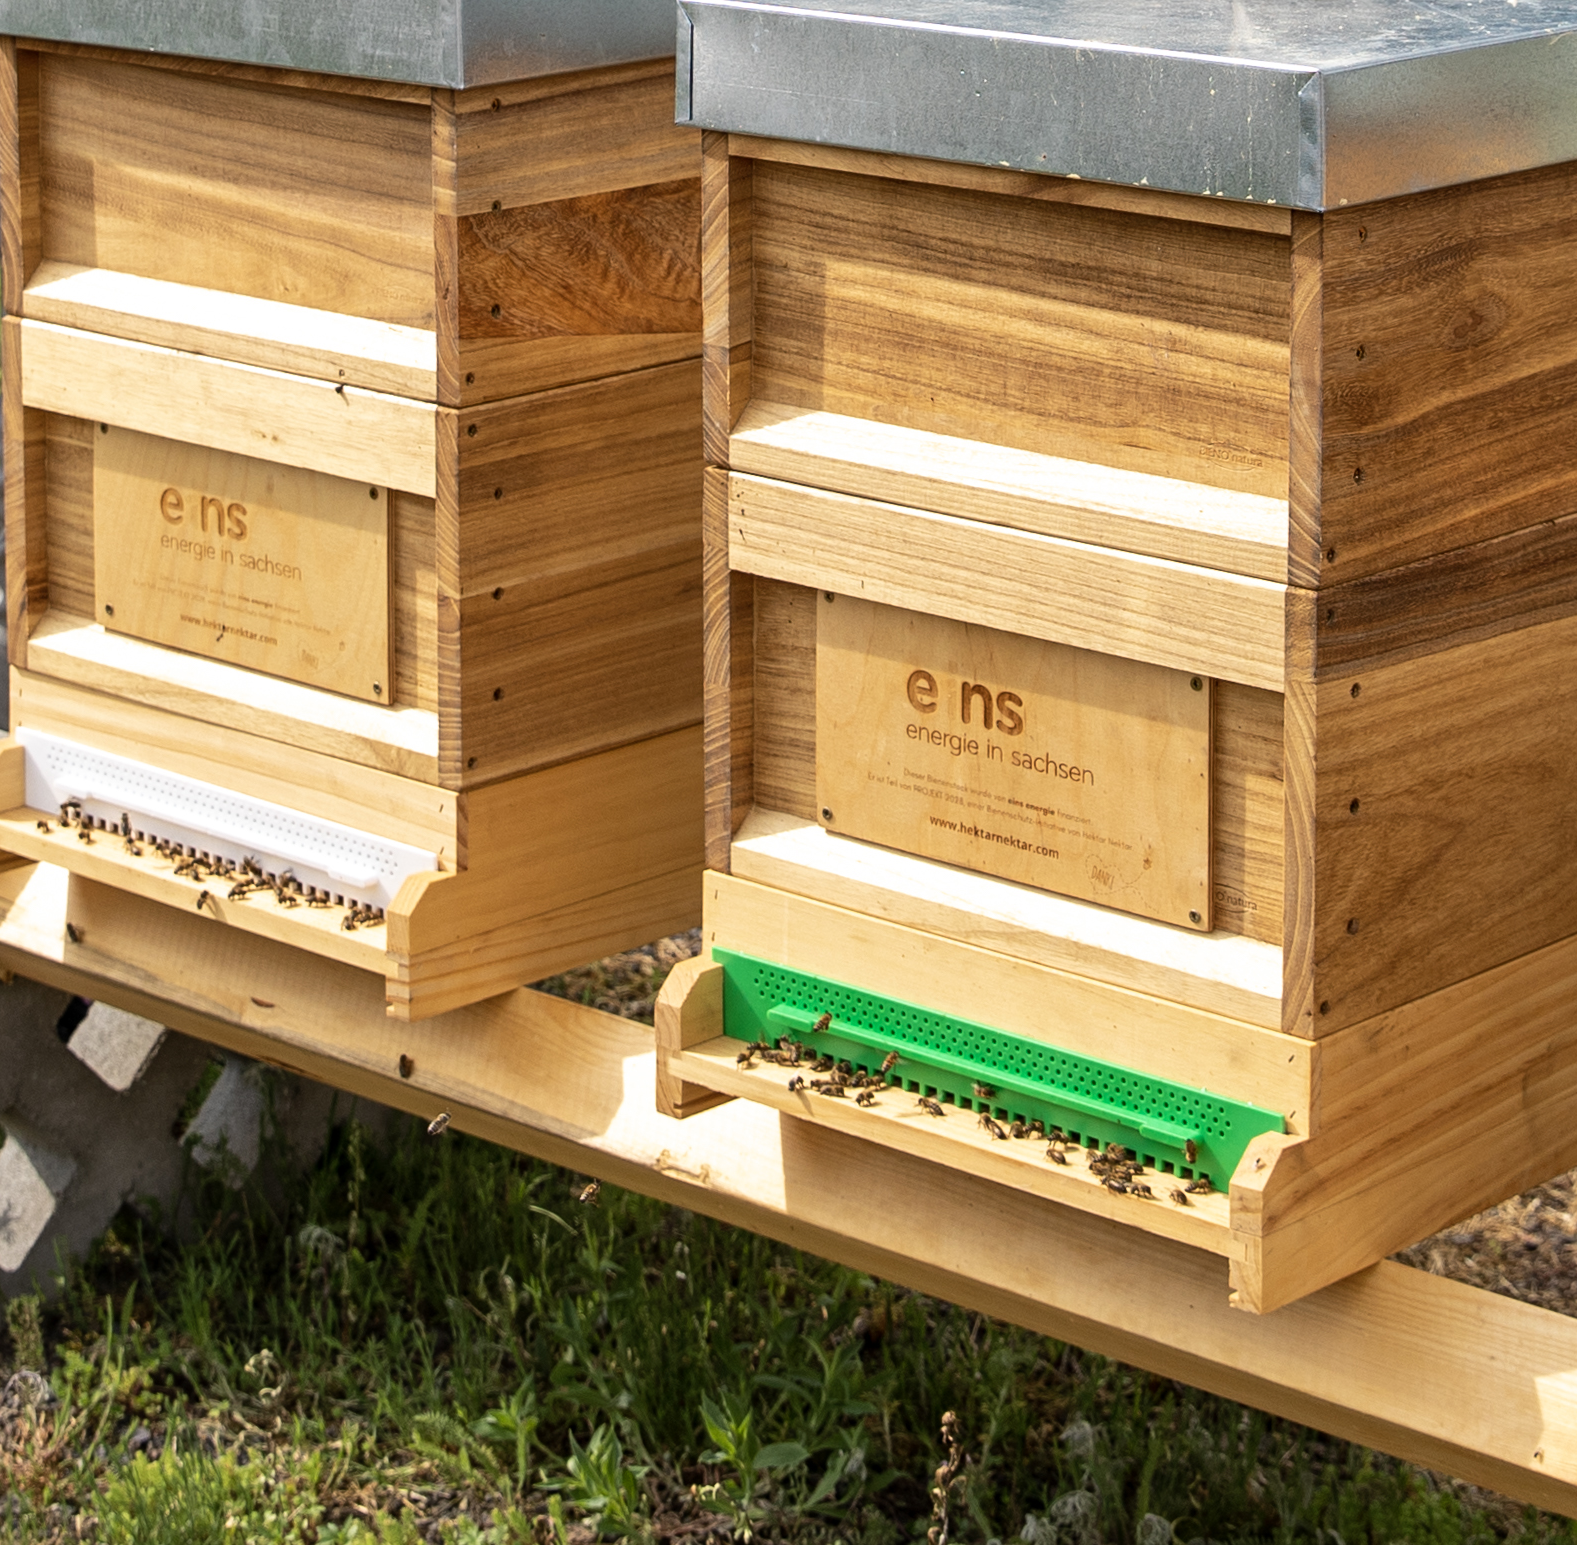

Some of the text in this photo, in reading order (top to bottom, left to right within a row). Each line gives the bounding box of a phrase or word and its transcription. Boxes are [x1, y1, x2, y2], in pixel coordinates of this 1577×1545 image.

[160, 534, 302, 581] energie in sachsen
[906, 723, 1095, 787] energie in sachsen
[929, 815, 1060, 860] www.hektarnektar.com
